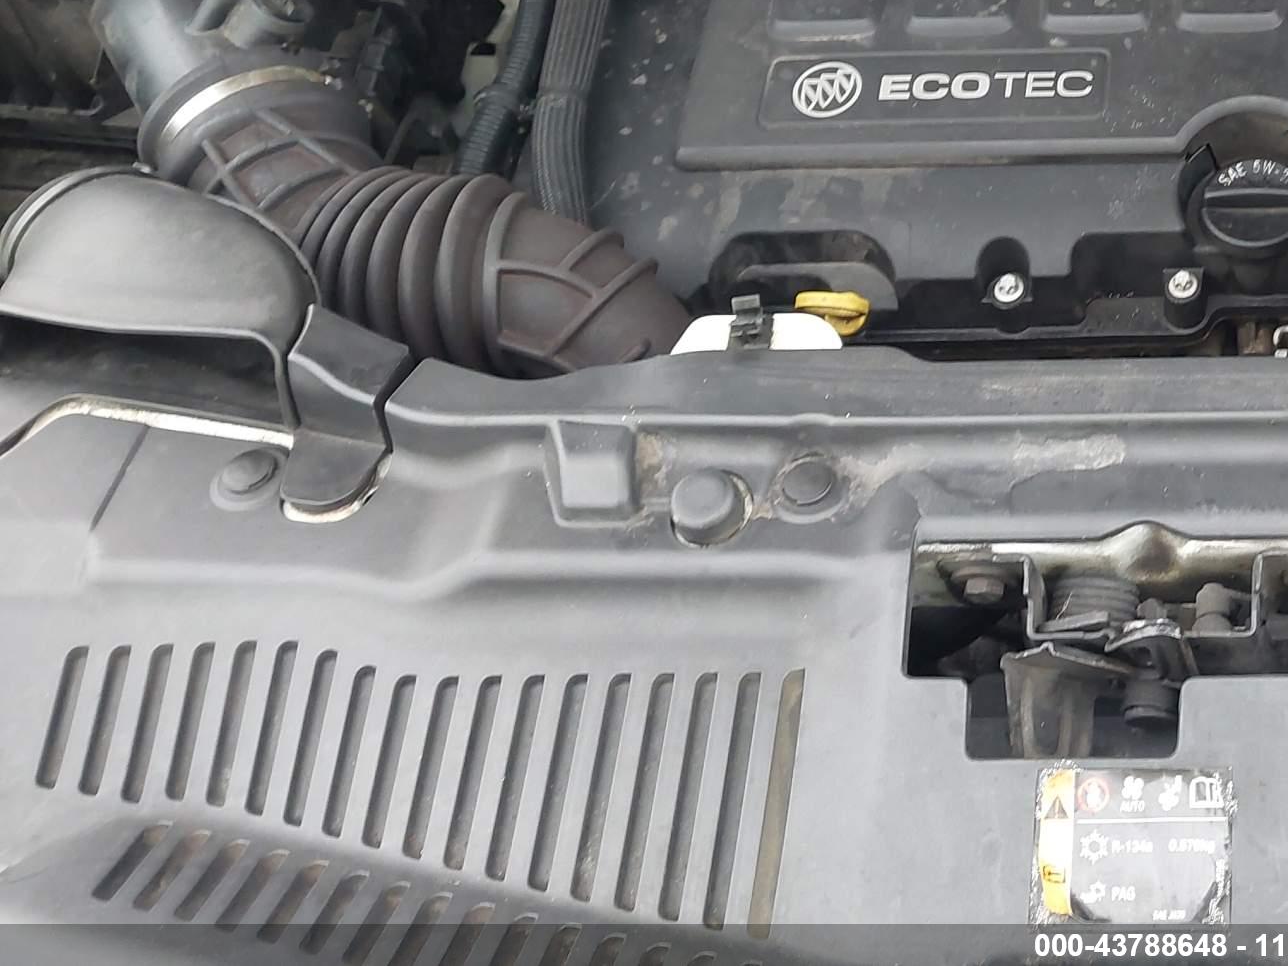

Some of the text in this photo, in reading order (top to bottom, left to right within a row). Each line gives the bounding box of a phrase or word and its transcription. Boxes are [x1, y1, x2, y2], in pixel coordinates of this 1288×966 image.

[877, 70, 1093, 101] ECOTEC
[1218, 161, 1247, 186] SAE
[1120, 800, 1146, 812] AUTO
[1111, 885, 1137, 901] PAG
